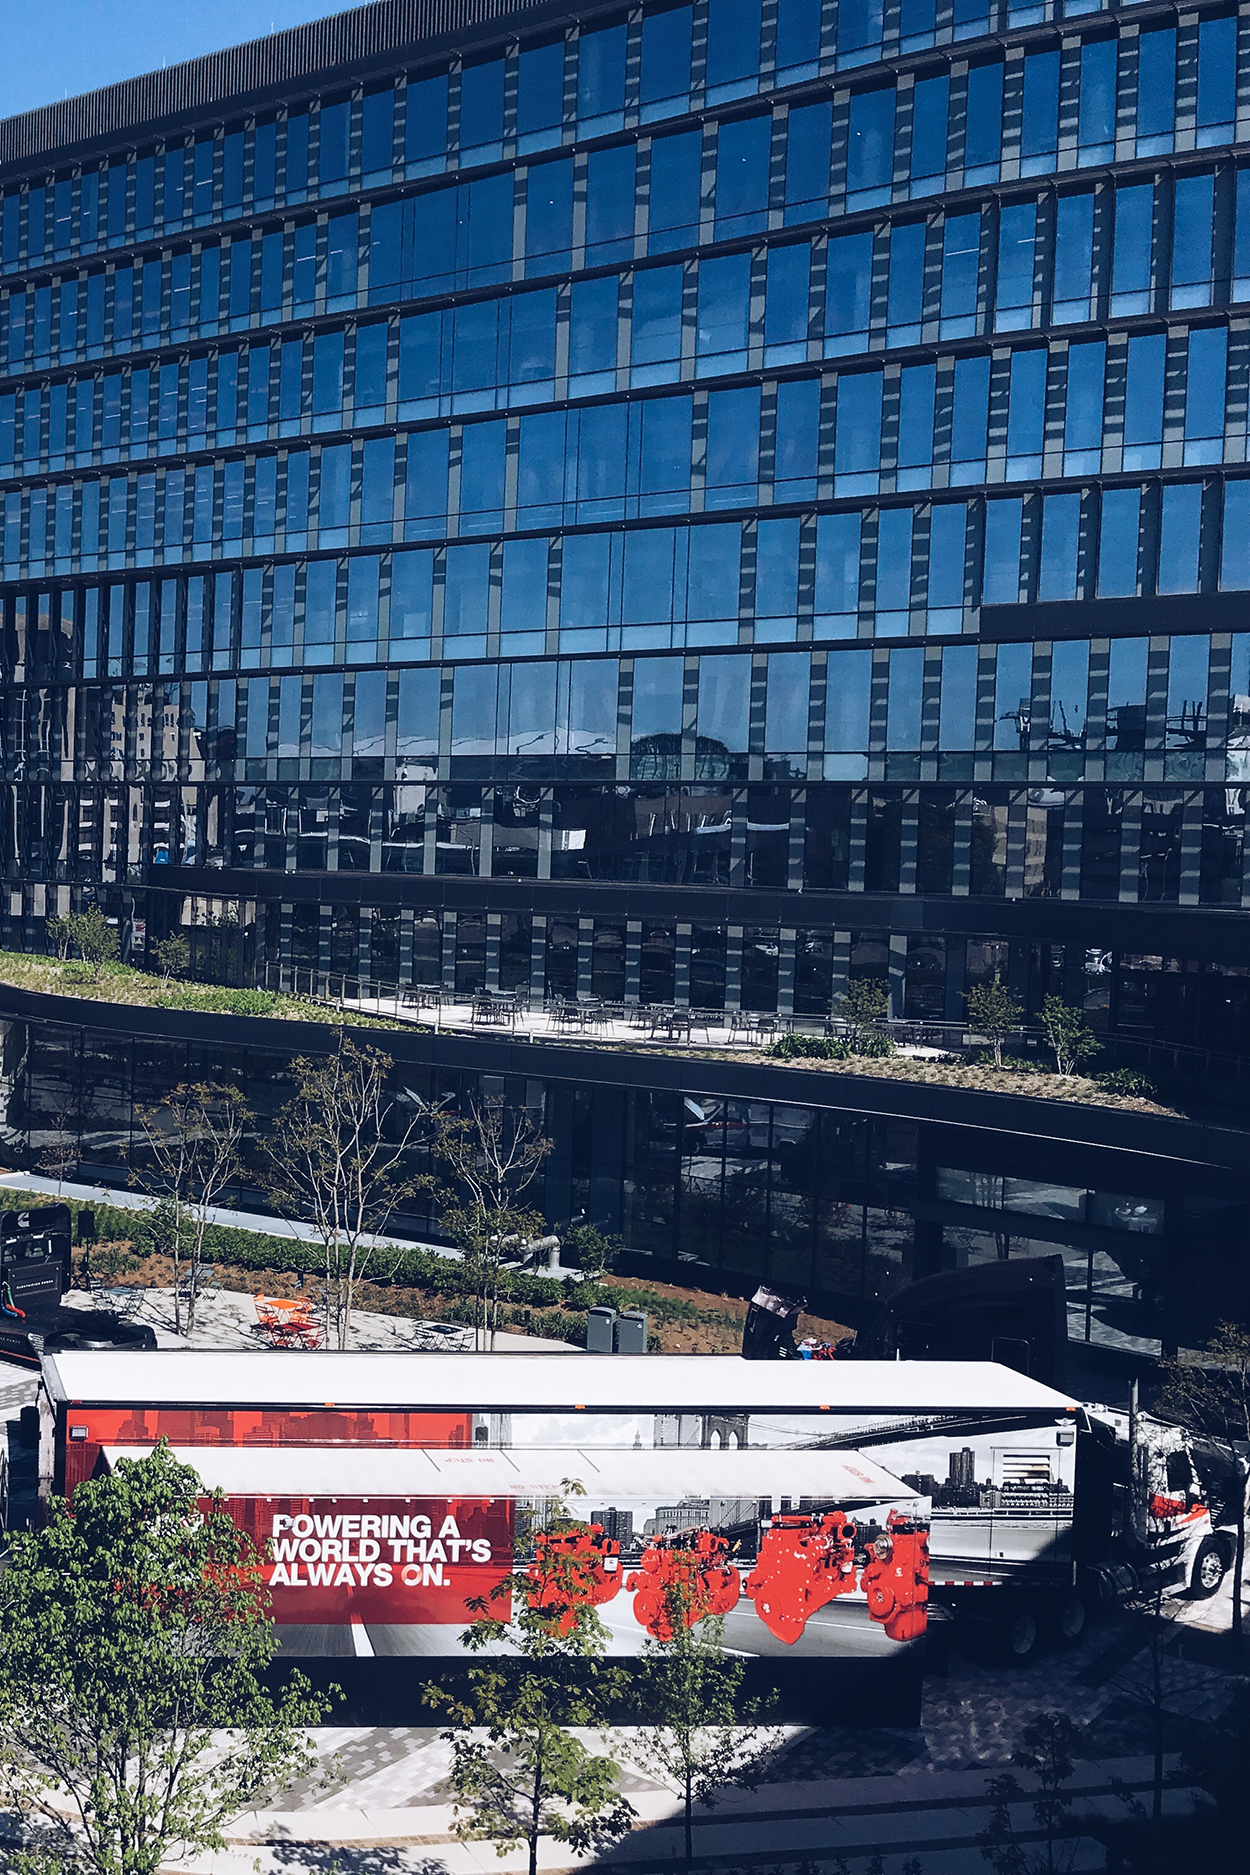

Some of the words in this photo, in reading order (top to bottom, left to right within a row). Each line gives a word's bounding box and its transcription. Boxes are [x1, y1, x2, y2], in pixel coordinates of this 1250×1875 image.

[272, 1514, 432, 1539] POWERING
[437, 1515, 460, 1539] A
[272, 1539, 381, 1563] WORLD
[388, 1539, 492, 1563] THAT'S
[269, 1563, 393, 1587] ALWAYS
[400, 1563, 451, 1587] ON.
